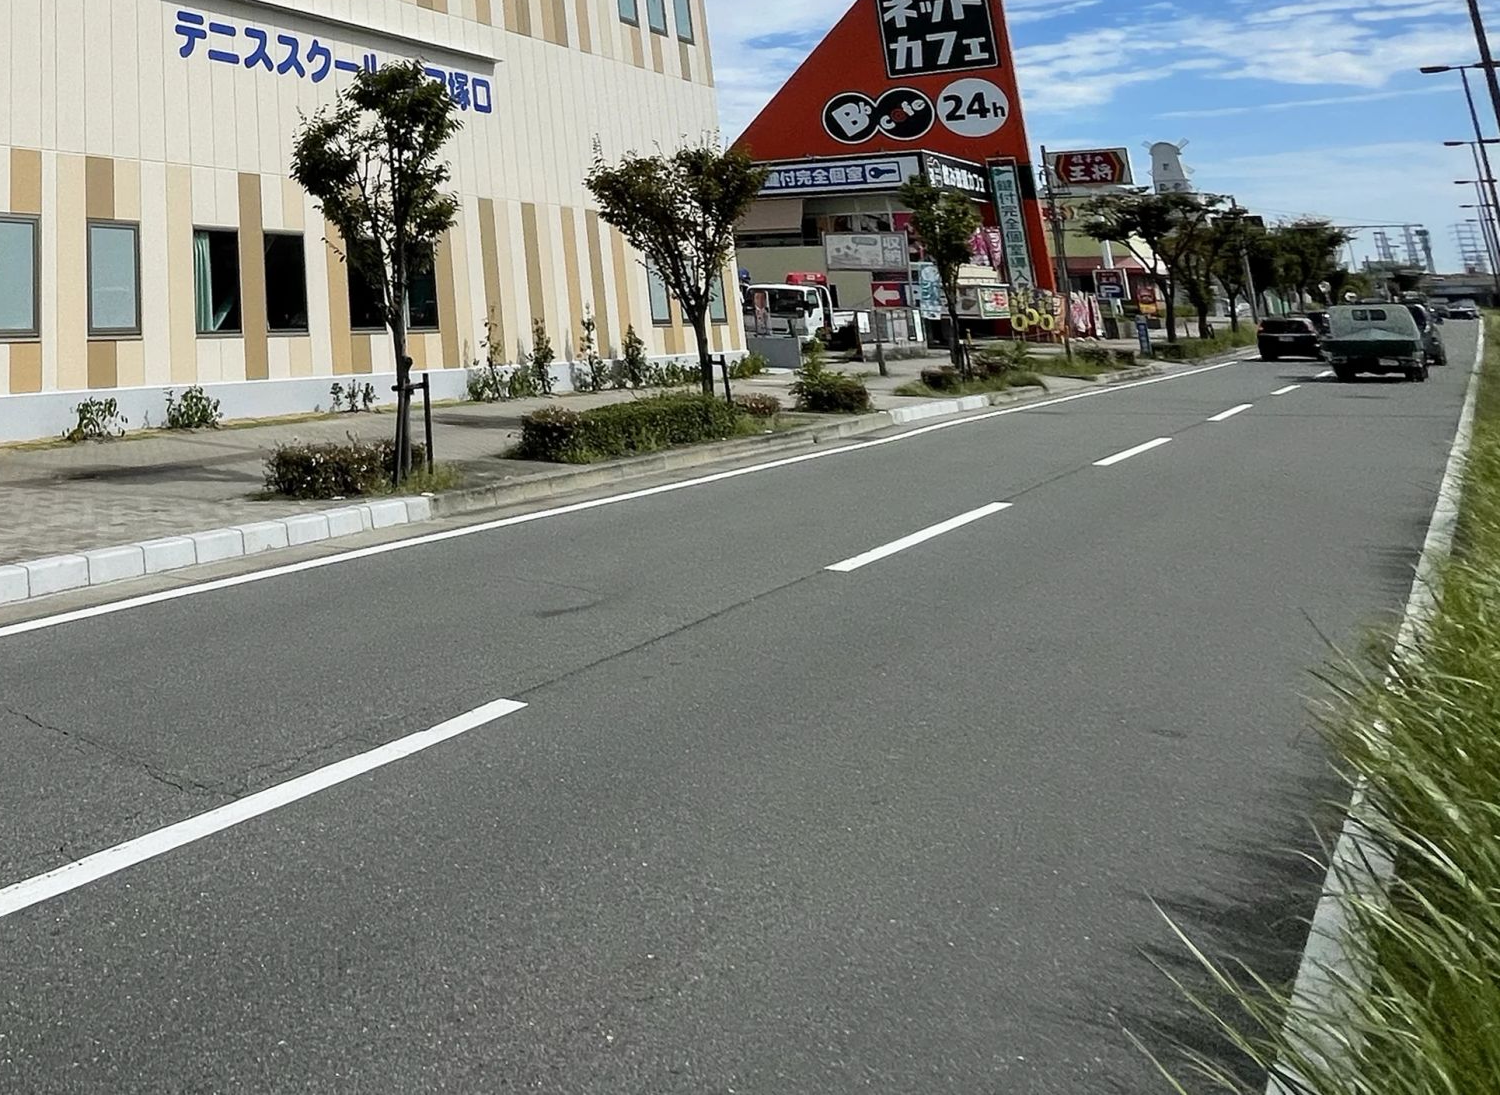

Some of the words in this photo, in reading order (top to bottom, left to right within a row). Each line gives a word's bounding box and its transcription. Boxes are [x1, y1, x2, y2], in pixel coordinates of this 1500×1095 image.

[174, 10, 492, 114] テニススクー塚口
[889, 30, 989, 70] カフェ
[943, 91, 1006, 121] 24h
[1068, 163, 1114, 181] 王将
